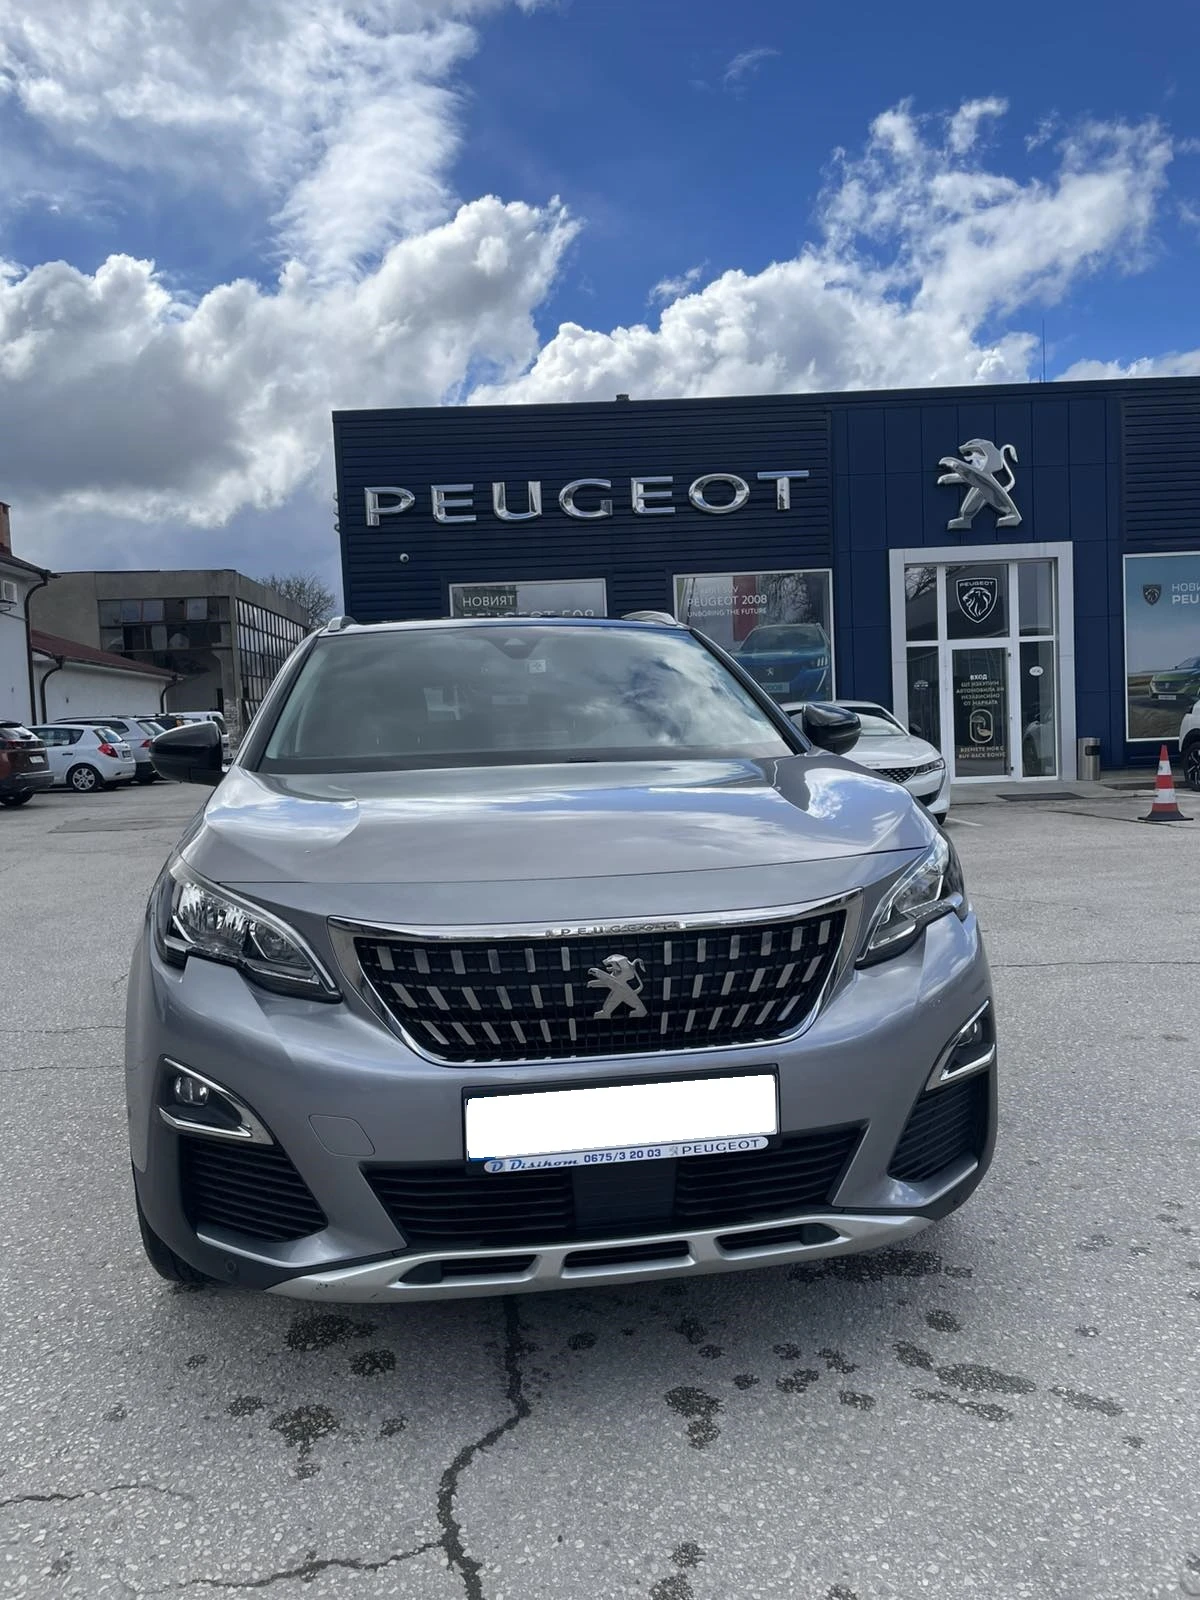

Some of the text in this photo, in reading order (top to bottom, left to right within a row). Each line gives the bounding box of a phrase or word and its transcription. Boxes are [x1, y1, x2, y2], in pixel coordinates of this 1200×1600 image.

[363, 469, 810, 527] PEUGEOT
[462, 595, 515, 607] НОВИЯТ
[687, 594, 768, 608] PEUGEOT 2008
[687, 609, 725, 618] UNBORING
[741, 607, 768, 616] FUTURE
[970, 673, 988, 681] ВХОД
[583, 1151, 626, 1163] 0675/3
[629, 1149, 644, 1160] 20
[647, 1148, 662, 1158] 03
[682, 1139, 761, 1155] PEUGEOT
